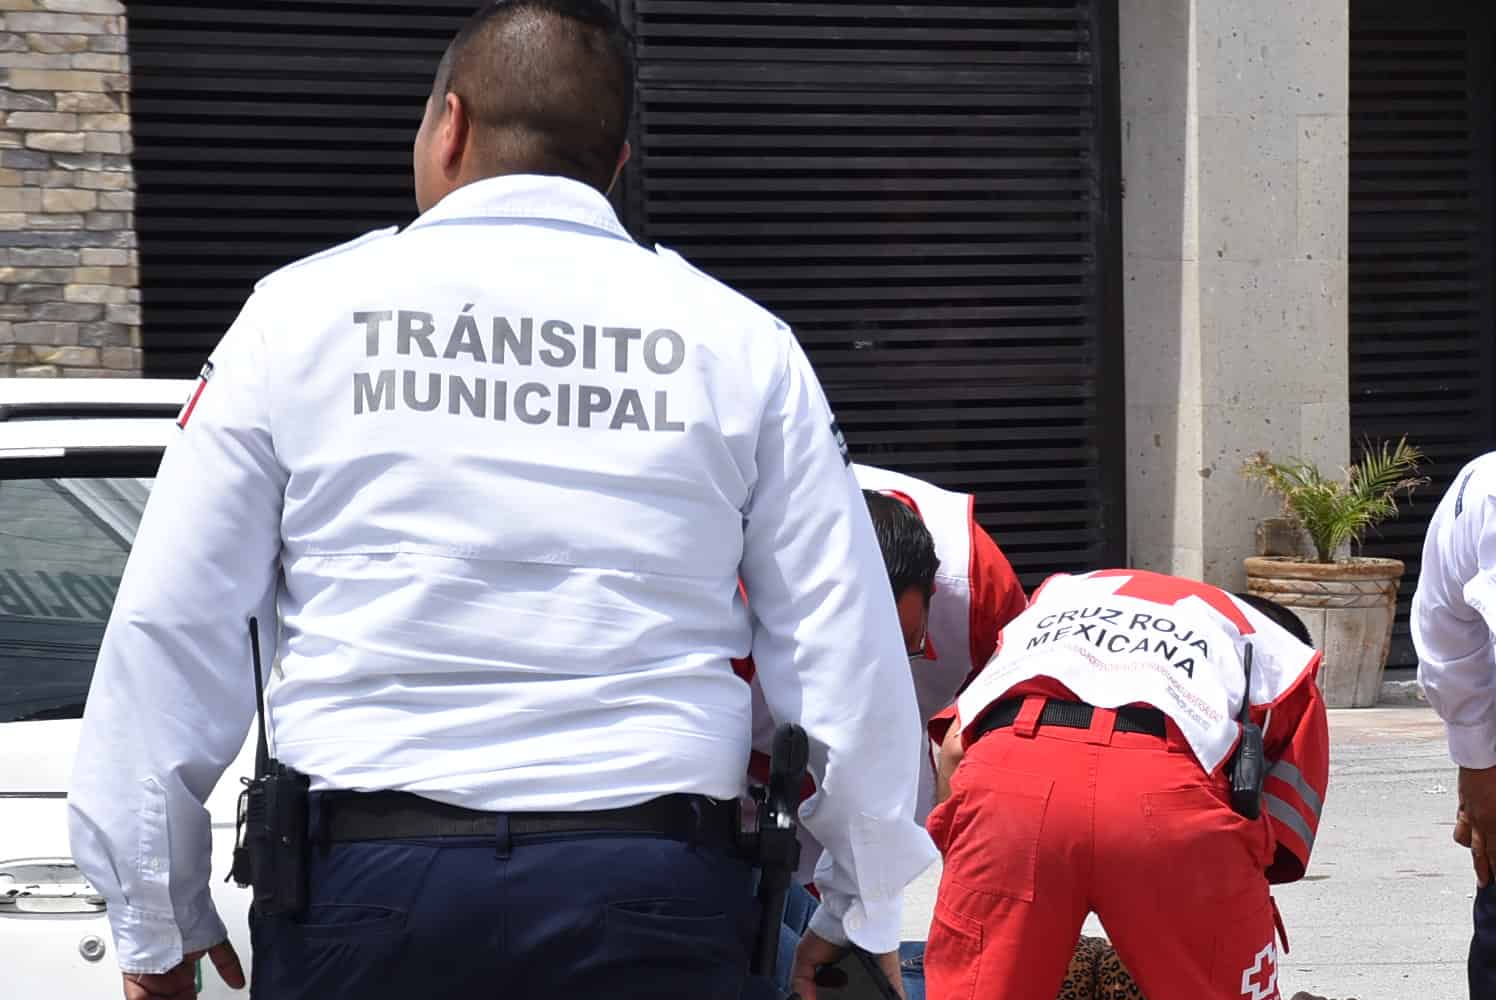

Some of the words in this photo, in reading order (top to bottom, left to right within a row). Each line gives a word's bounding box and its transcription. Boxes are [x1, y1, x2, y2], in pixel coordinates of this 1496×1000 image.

[353, 303, 686, 376] TRÁNSITO
[353, 369, 686, 433] MUNICIPAL
[1026, 622, 1195, 679] MEXICANA
[1037, 606, 1124, 630] CRUZ
[1128, 612, 1209, 659] ROJA
